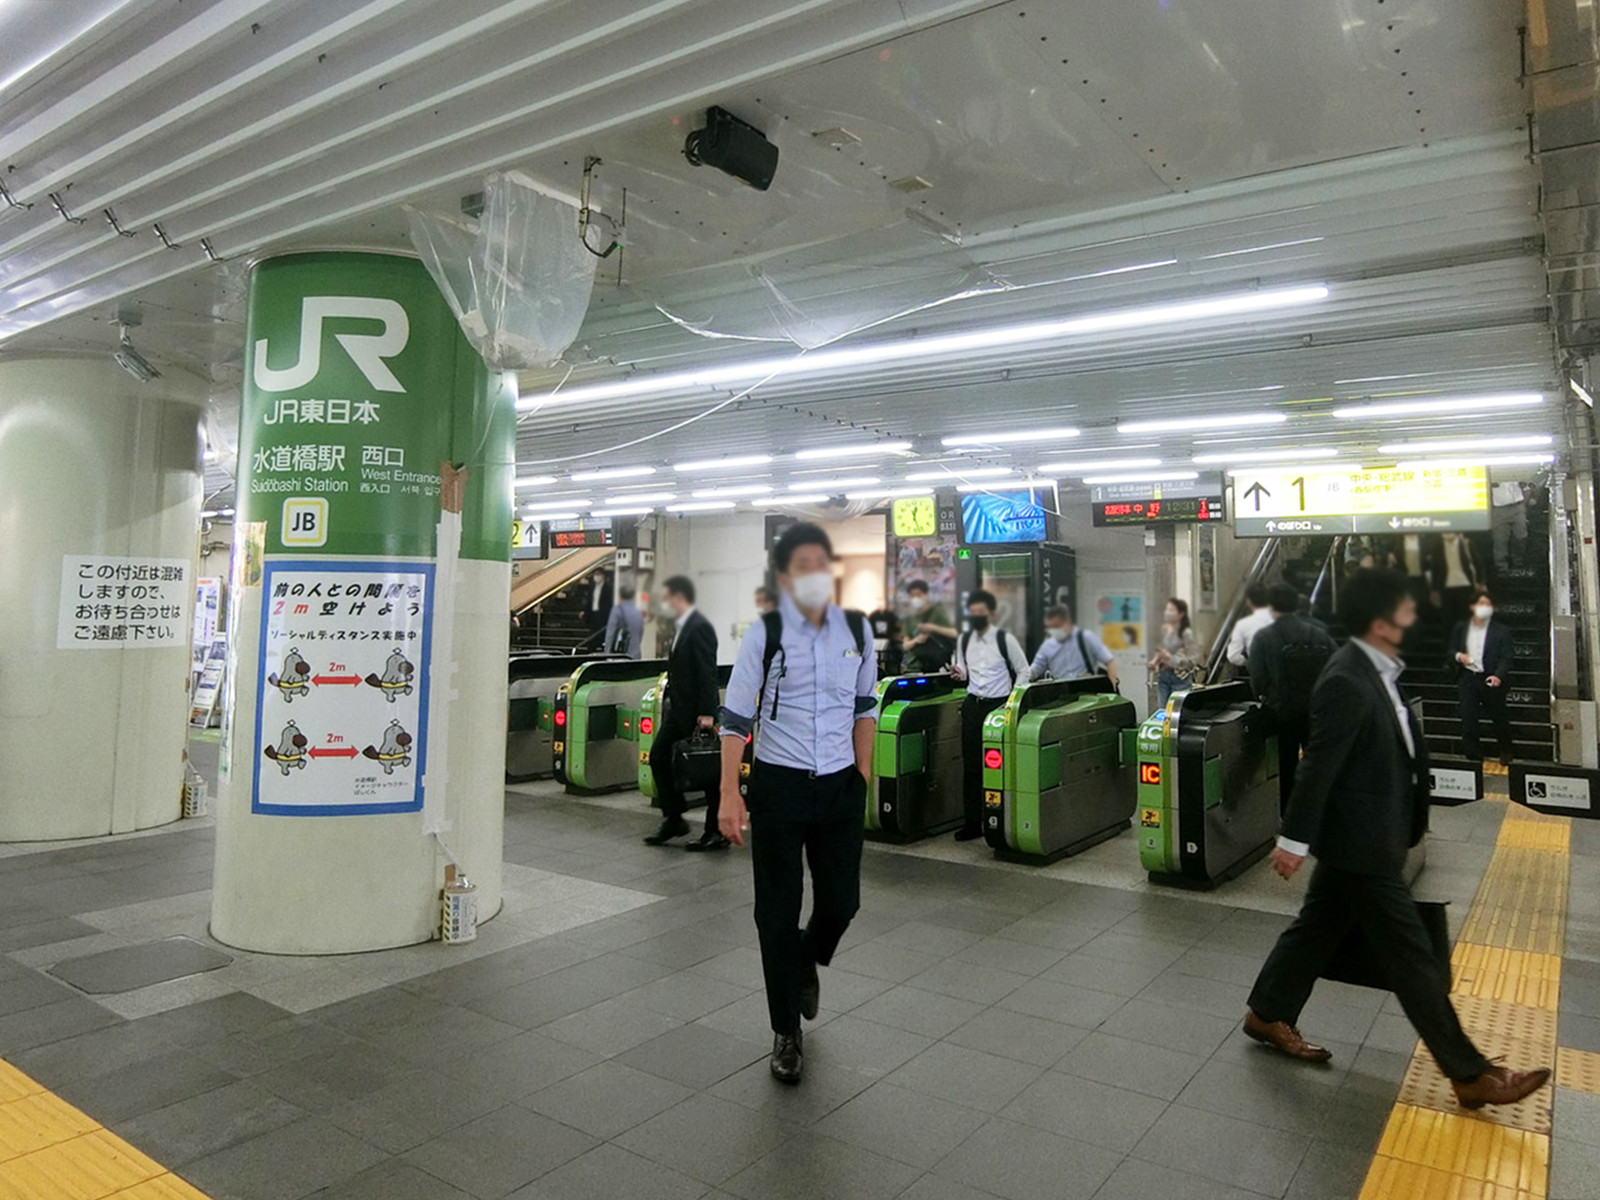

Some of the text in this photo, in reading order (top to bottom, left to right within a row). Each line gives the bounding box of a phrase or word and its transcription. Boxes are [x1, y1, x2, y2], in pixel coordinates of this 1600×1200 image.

[253, 296, 410, 393] JR
[263, 399, 380, 425] JR東日本
[252, 445, 404, 473] 水道橋駅 西口
[361, 467, 391, 480] West
[304, 477, 348, 492] Station
[1291, 477, 1304, 511] 1
[291, 512, 315, 532] JB
[511, 522, 520, 545] 2
[78, 564, 184, 582] この付近は混雑
[78, 585, 165, 600] しますので、
[273, 583, 421, 598] 前の人との間隔を
[75, 603, 181, 620] お待ち合わせは
[74, 624, 175, 641] ご遠慮下さい。
[270, 629, 418, 642] ソーシャルディスタンス実施中
[329, 661, 346, 672] 2m
[984, 714, 1005, 728] IC
[327, 733, 344, 743] 2m
[1140, 726, 1162, 740] IC
[1141, 764, 1161, 783] IC
